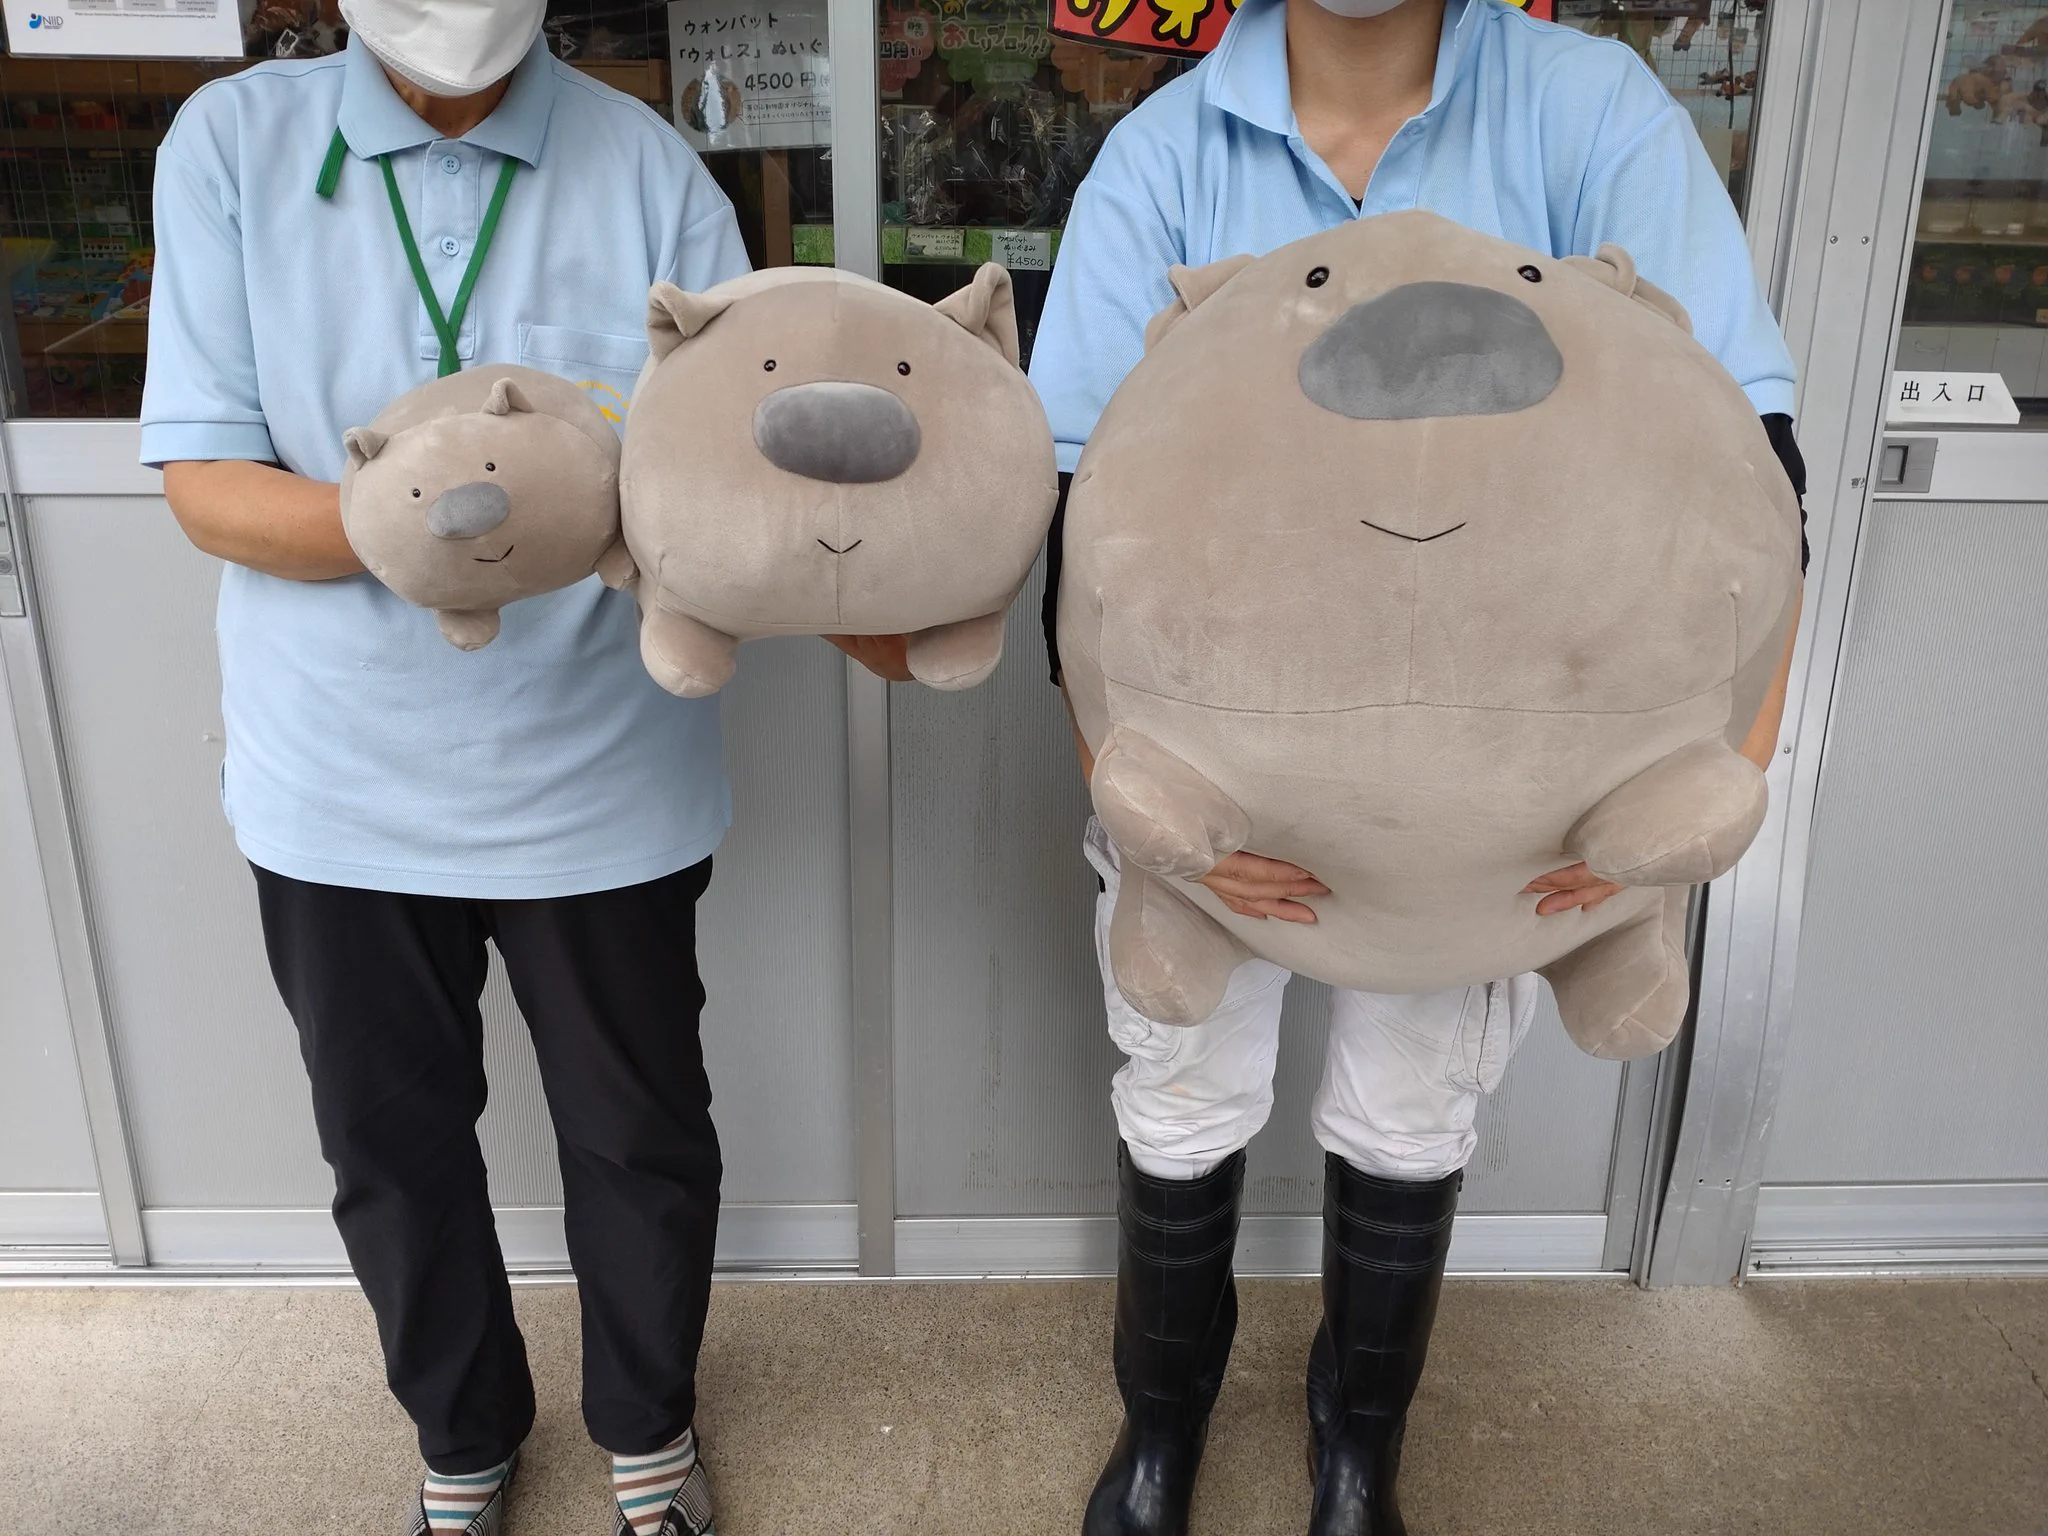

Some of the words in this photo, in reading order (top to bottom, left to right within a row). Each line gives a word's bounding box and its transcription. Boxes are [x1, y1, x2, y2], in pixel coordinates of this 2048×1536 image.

[684, 12, 778, 36] ウォンバット
[680, 38, 830, 63] 「ウォレス」ぬいぐ
[1008, 252, 1044, 268] ¥4500
[1900, 381, 1985, 402] 出入口
